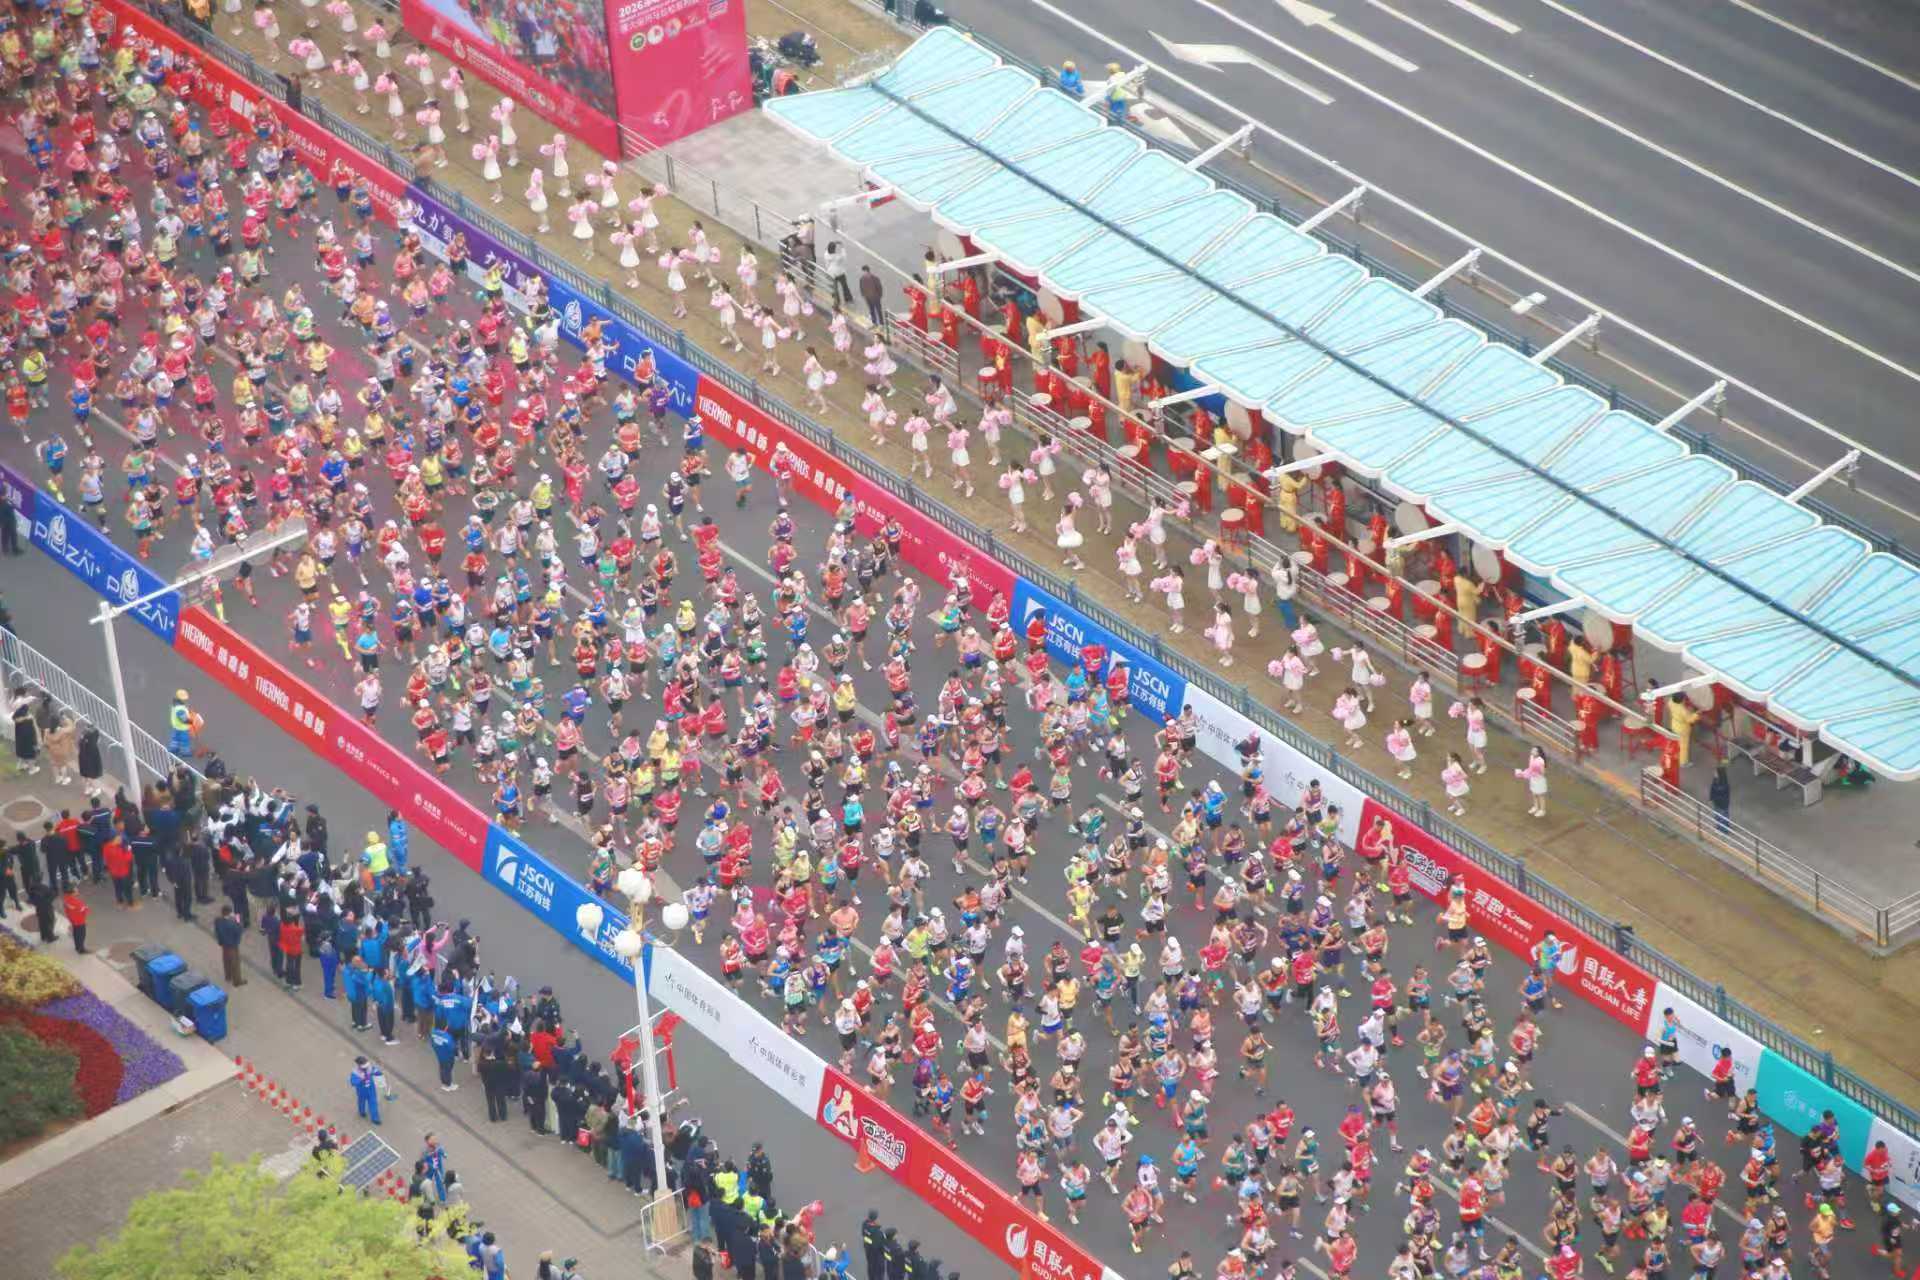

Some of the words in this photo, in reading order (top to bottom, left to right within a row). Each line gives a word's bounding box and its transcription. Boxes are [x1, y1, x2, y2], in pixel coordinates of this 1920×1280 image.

[1050, 613, 1084, 645] JSCN
[1134, 668, 1170, 700] JSCN
[518, 878, 551, 911] 江苏有线
[520, 863, 554, 896] JSCN
[1581, 978, 1620, 1007] GUOLIAN
[1621, 1002, 1641, 1022] LIFE
[1584, 956, 1649, 1011] 国联人寿
